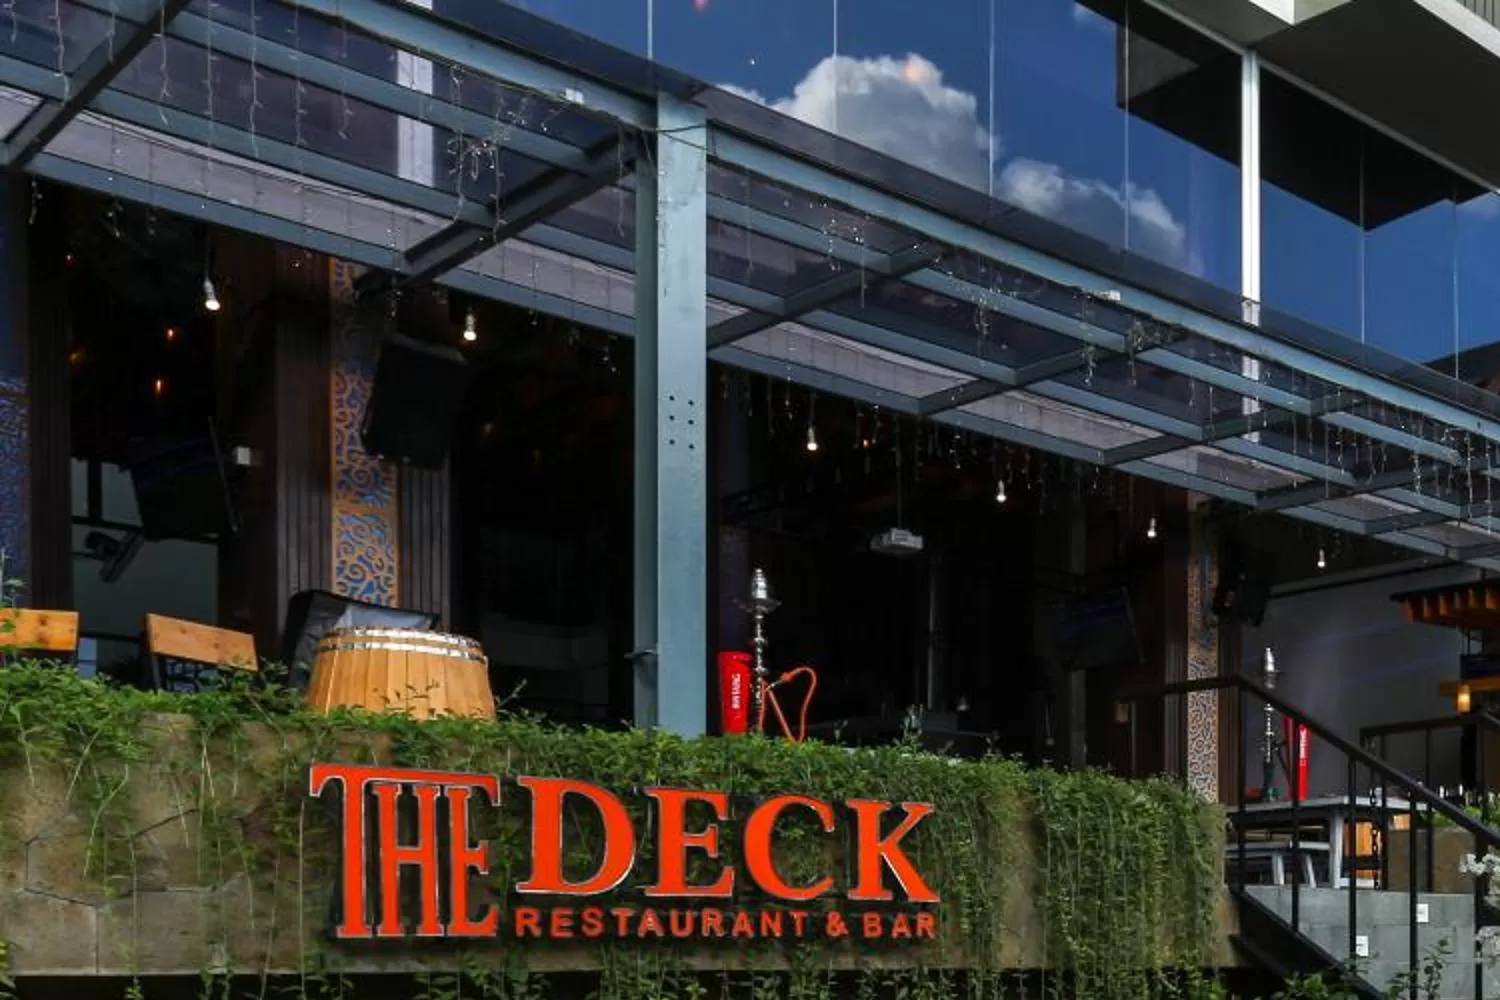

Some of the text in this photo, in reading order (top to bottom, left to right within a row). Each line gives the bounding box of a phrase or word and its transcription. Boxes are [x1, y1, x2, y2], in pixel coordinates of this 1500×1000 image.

[309, 763, 941, 938] THE DECK
[514, 907, 938, 939] RESTAURANT & BAR
